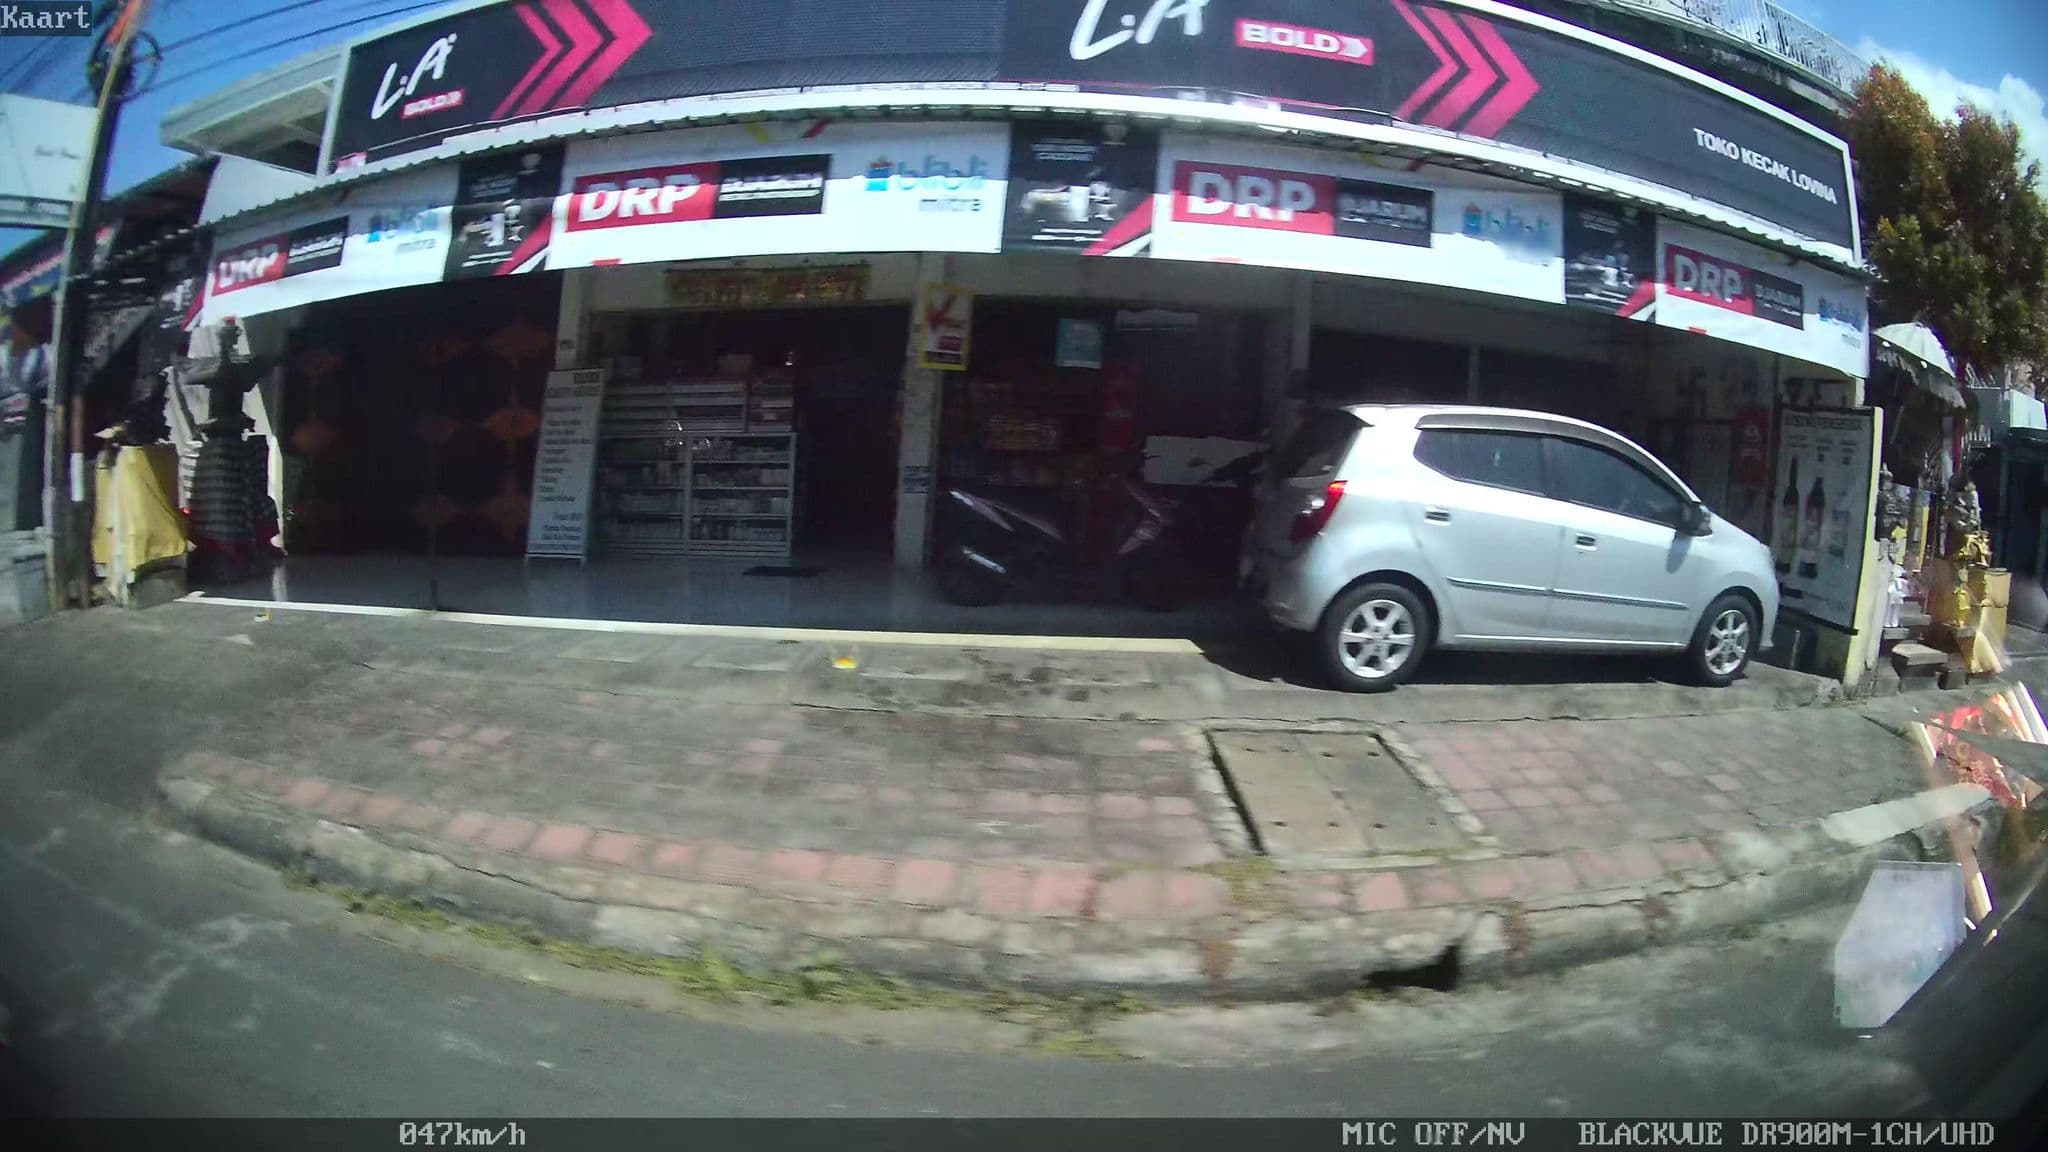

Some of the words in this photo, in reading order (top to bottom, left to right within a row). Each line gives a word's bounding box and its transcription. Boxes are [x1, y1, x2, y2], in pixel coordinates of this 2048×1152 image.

[1243, 23, 1340, 53] BOLD
[1693, 127, 1739, 160] TOKO
[1741, 147, 1791, 183] KECAK
[1791, 169, 1838, 205] LOVINA
[578, 173, 699, 222] DRP
[1187, 171, 1316, 222] DRP
[1674, 254, 1744, 303] DRP
